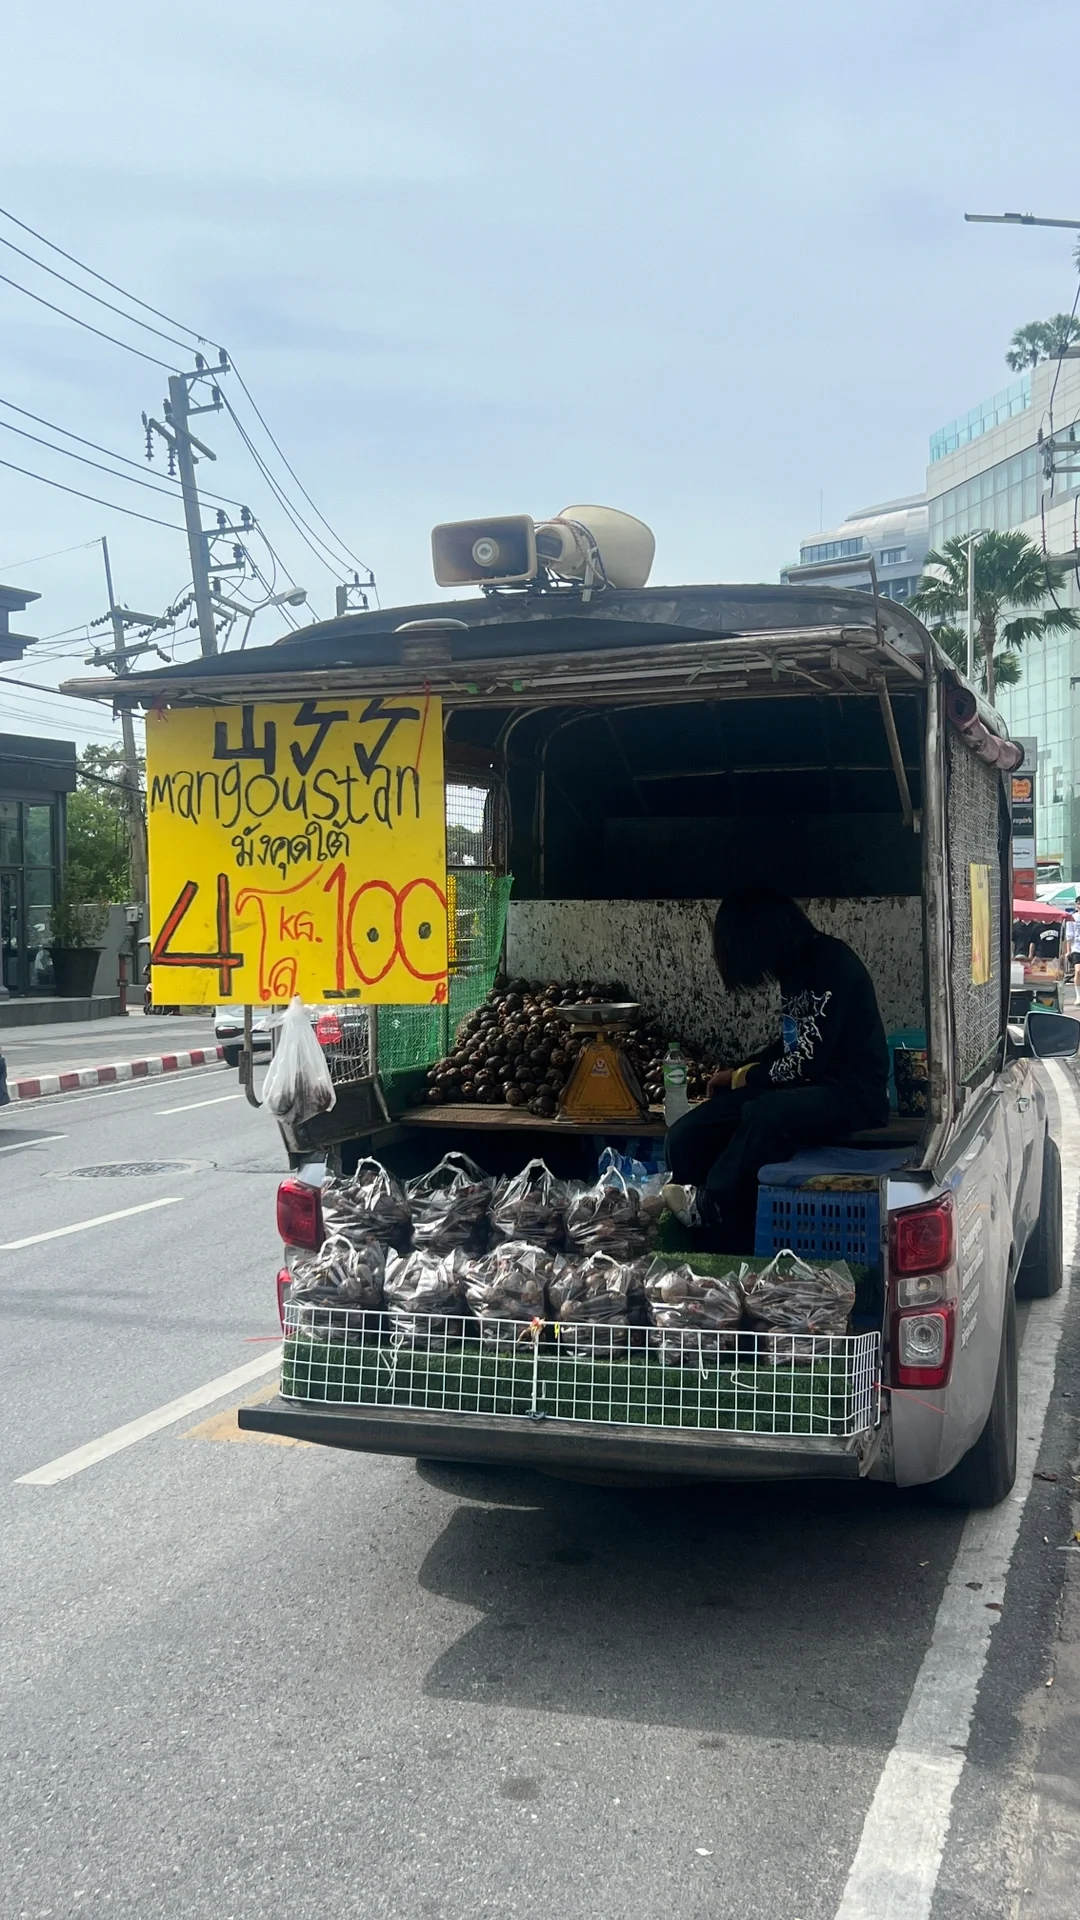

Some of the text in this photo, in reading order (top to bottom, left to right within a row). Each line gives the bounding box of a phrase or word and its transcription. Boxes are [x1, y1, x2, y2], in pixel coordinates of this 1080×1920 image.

[231, 819, 350, 881] มังคุดใต้
[151, 872, 244, 997] 4
[323, 862, 448, 999] 100
